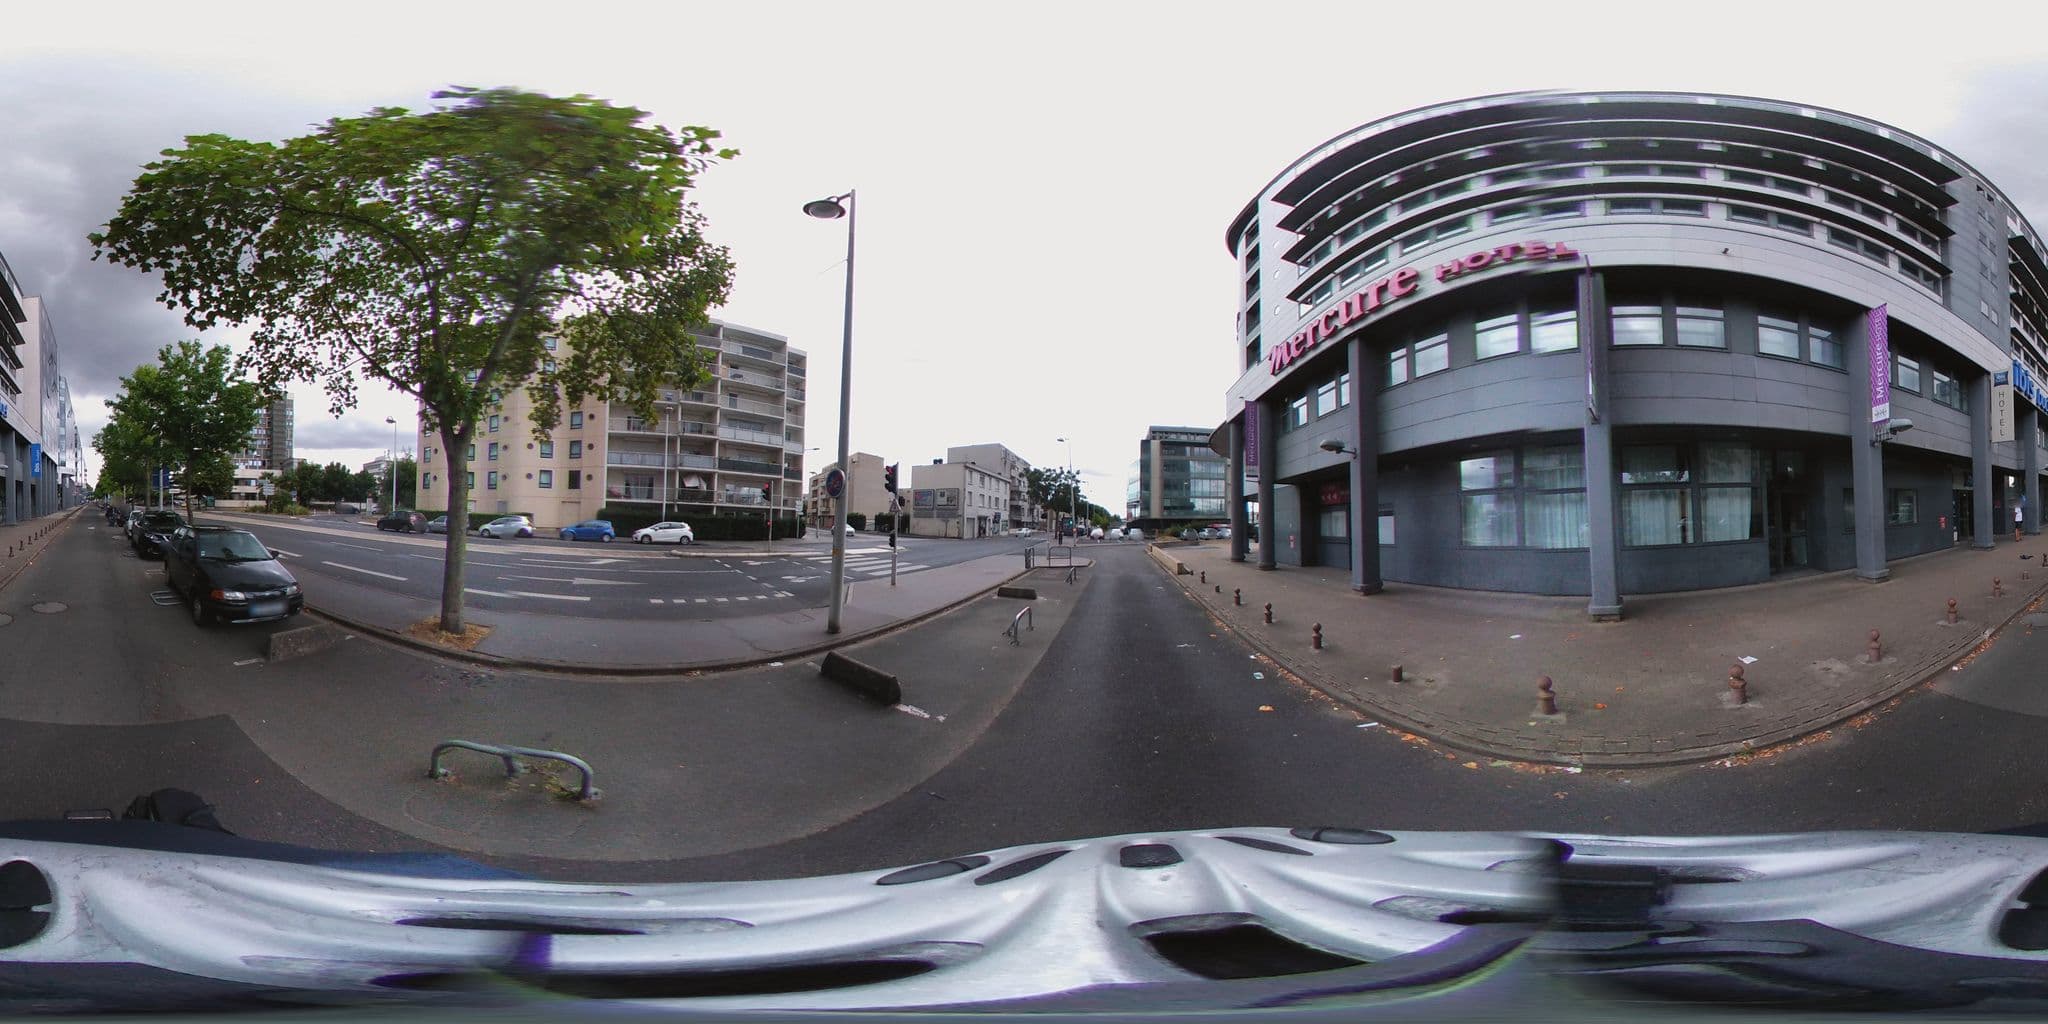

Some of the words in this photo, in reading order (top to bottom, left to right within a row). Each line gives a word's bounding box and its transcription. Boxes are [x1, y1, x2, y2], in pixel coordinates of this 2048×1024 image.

[1268, 266, 1419, 376] Mercure
[1434, 240, 1580, 284] HOTEL
[1875, 343, 1885, 400] Mercure
[2013, 359, 2034, 399] ibis
[1998, 391, 2006, 437] HOTEL
